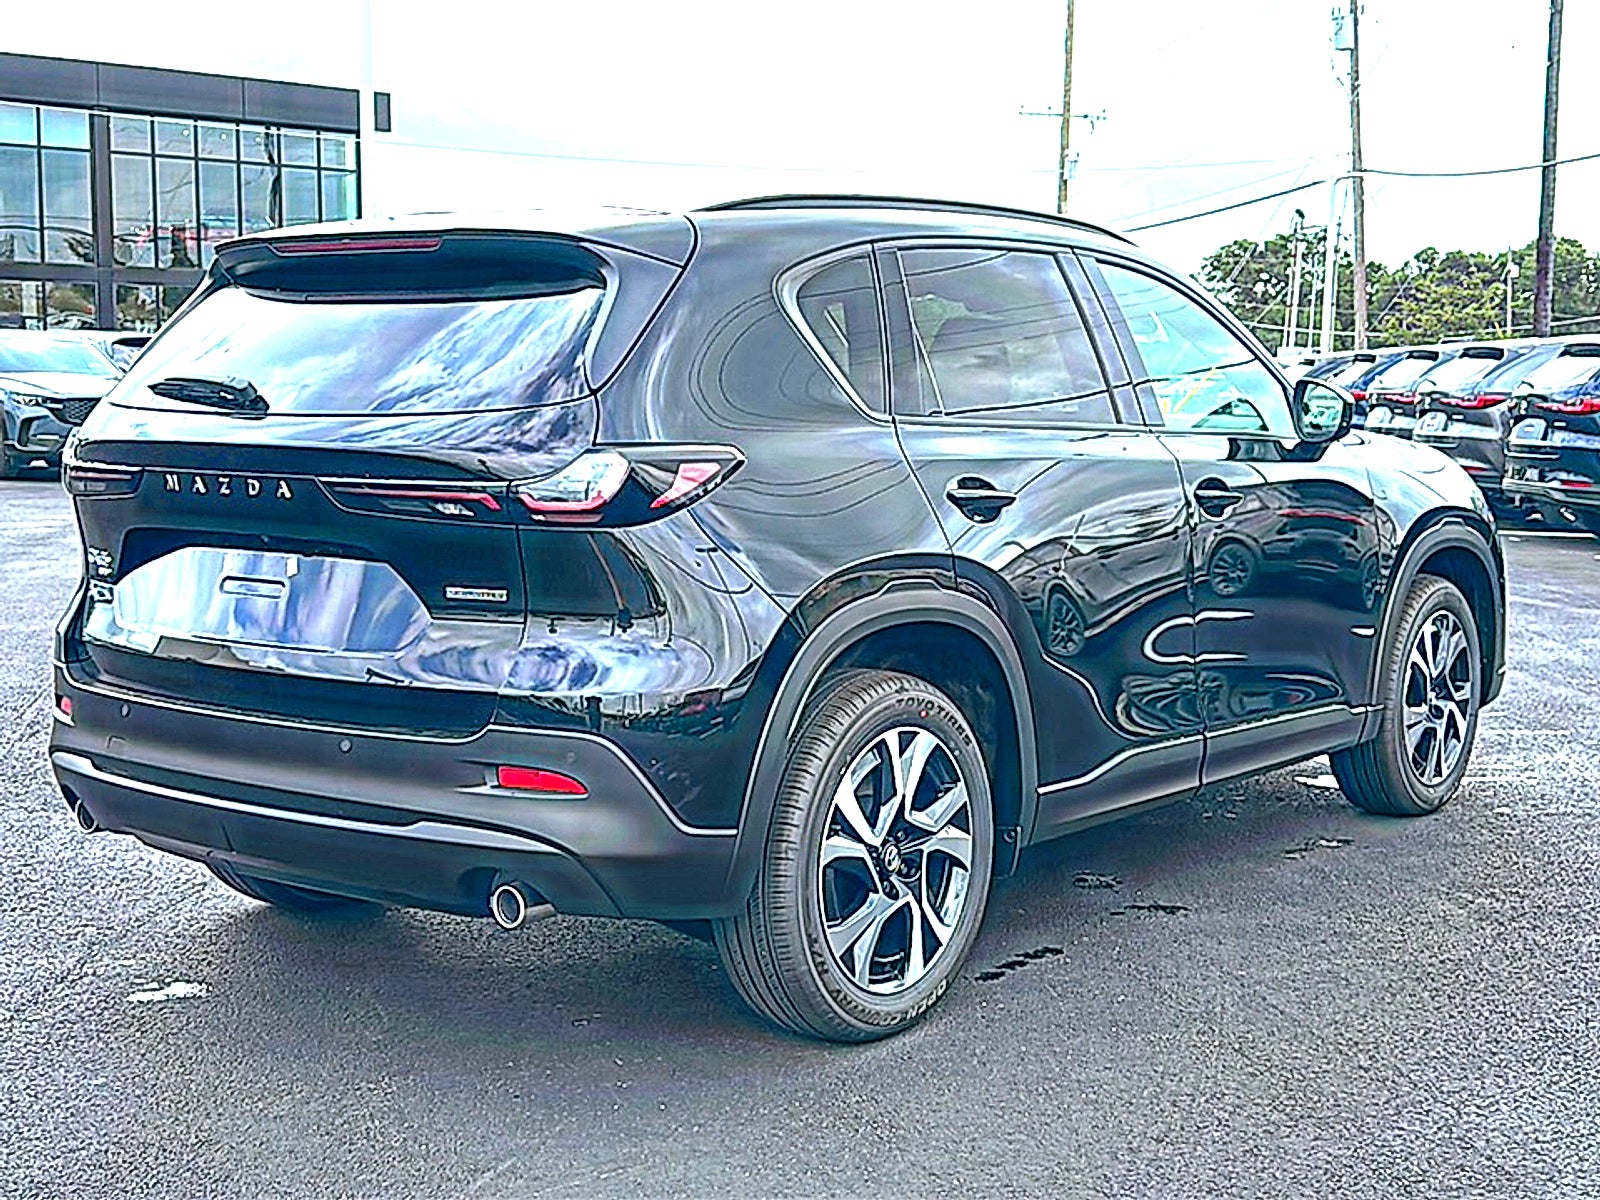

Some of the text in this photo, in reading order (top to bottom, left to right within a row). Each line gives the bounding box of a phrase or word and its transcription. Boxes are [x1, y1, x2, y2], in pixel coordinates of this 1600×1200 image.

[165, 474, 293, 498] MAZDA
[895, 697, 972, 747] TOYO TIRES
